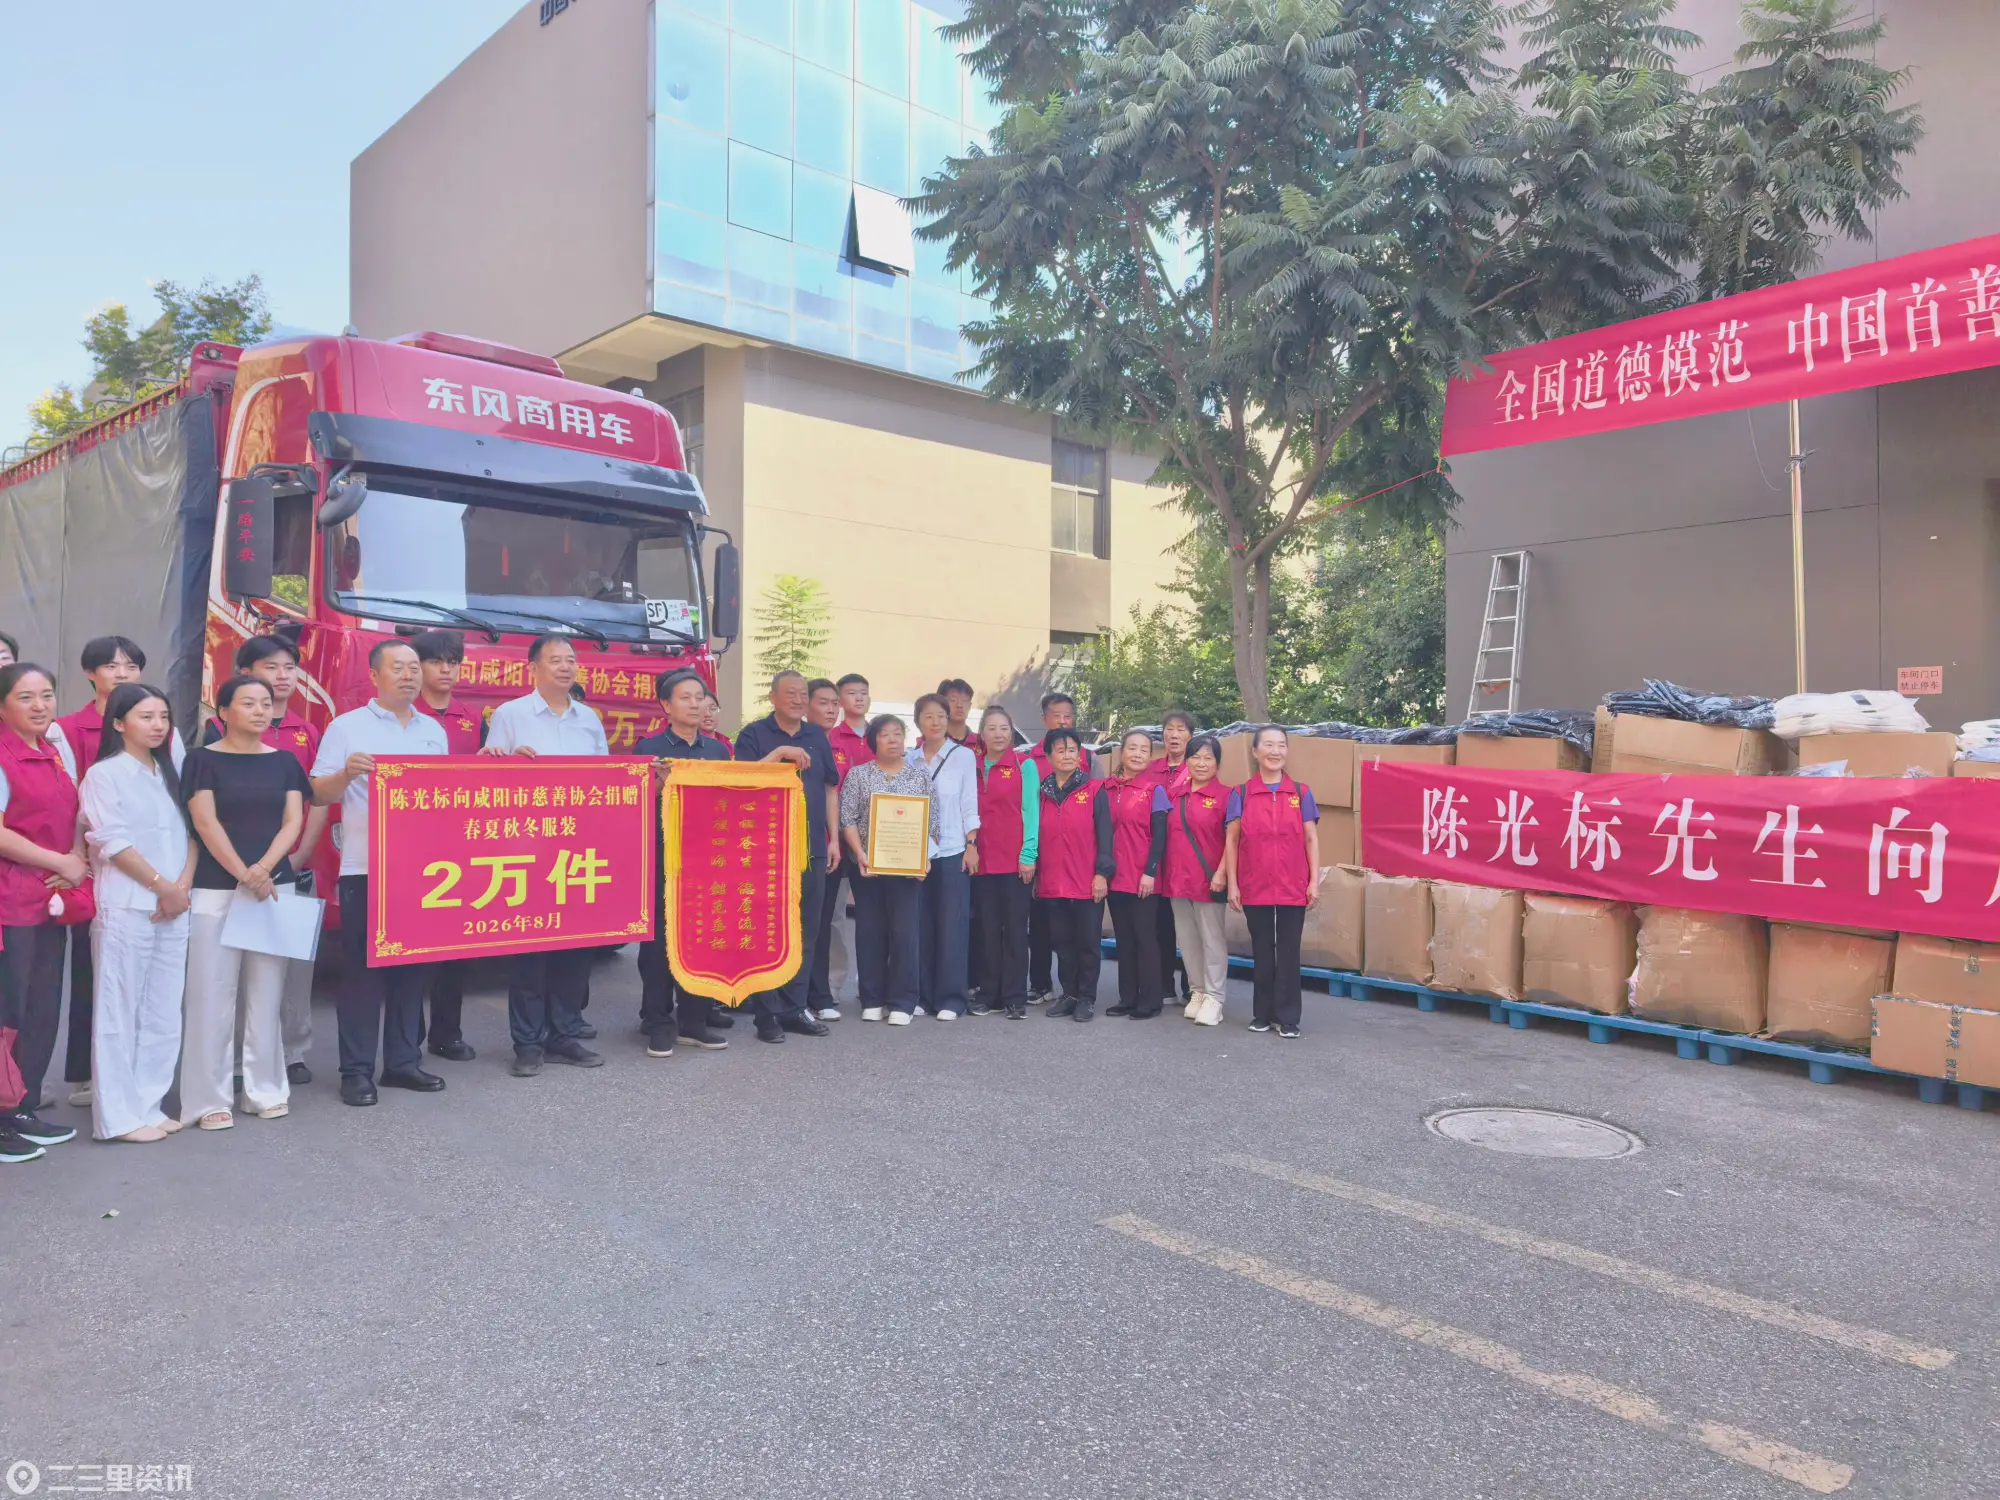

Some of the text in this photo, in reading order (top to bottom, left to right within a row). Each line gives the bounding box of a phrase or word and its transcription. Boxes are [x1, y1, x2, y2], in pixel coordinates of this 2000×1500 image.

[1492, 263, 2000, 426] 全国道德模范 中国首善
[422, 377, 634, 445] 东风商用车
[236, 499, 256, 561] 一路平安
[1900, 670, 1939, 679] 车间门口
[1900, 681, 1940, 690] 禁止停车
[389, 784, 640, 811] 陈光标向咸阳市慈善协会捐赠
[463, 815, 578, 841] 春夏秋冬服装
[1422, 785, 2000, 906] 陈光标先生向
[421, 848, 612, 910] 2万件
[463, 912, 562, 935] 2026年8月
